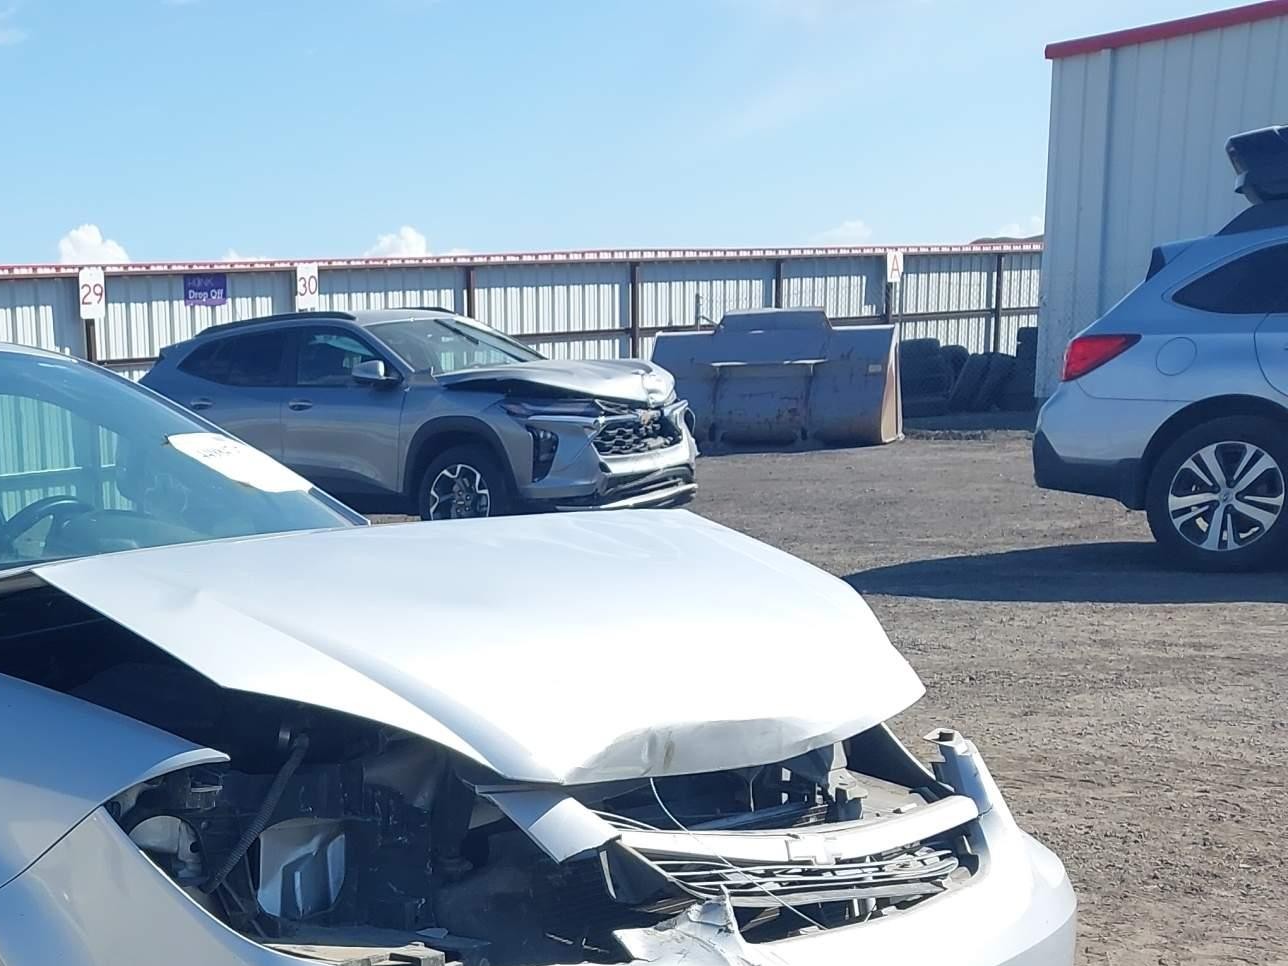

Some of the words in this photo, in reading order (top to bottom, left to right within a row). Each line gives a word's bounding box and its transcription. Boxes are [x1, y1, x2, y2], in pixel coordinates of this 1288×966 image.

[890, 254, 901, 279] A
[80, 283, 104, 306] 29
[188, 289, 209, 302] Drop
[210, 288, 224, 300] Off
[298, 275, 318, 297] 30
